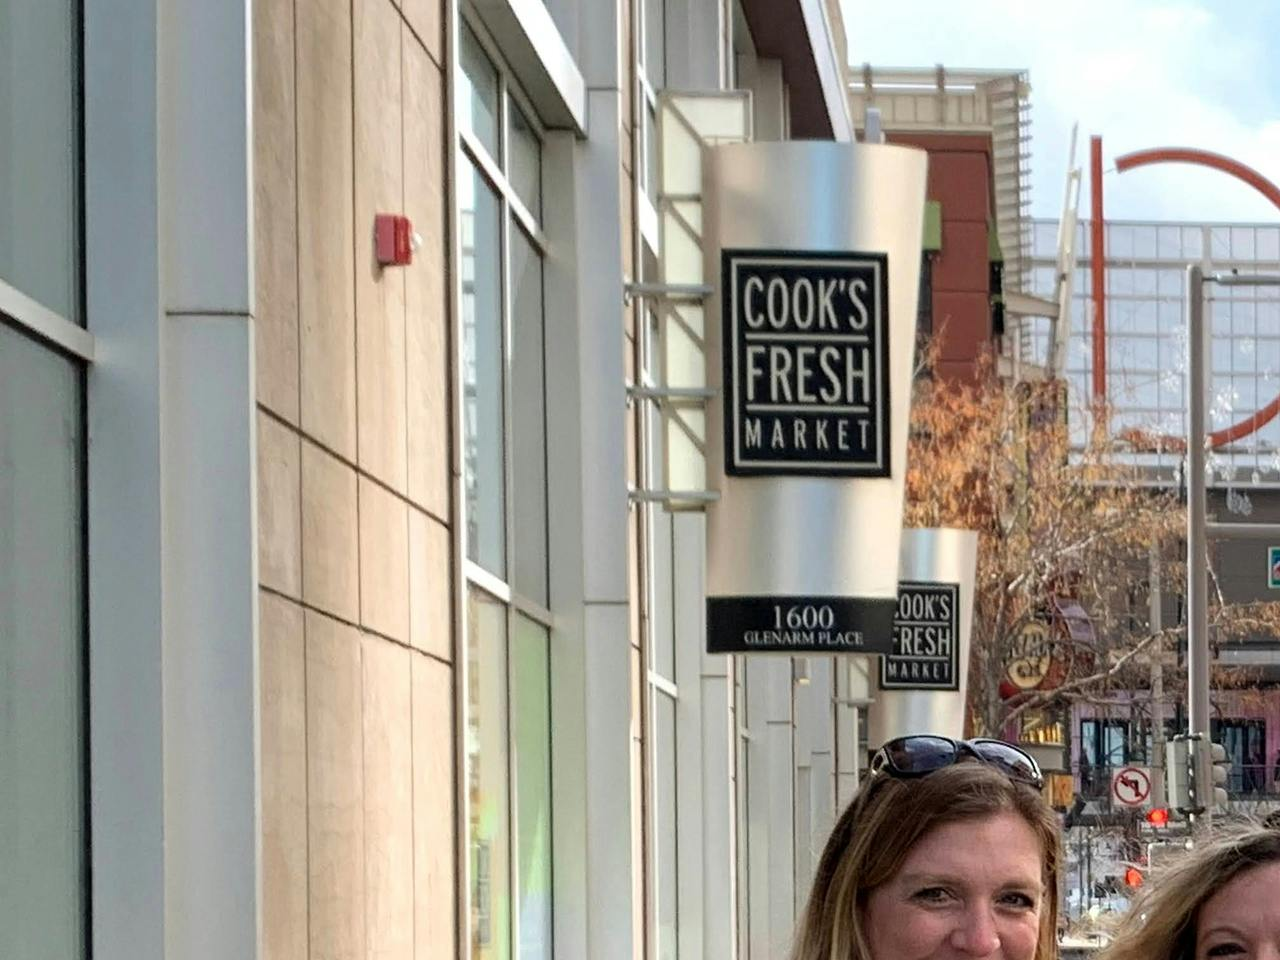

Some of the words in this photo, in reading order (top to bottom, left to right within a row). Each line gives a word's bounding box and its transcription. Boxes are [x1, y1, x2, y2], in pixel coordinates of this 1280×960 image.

[745, 276, 869, 331] COOK'S
[746, 345, 871, 404] FRESH
[746, 418, 871, 451] MARKET
[773, 605, 834, 630] 1600
[894, 595, 950, 621] OOK'S
[743, 631, 815, 646] GLENARM
[818, 631, 864, 646] PLACE
[888, 662, 950, 680] MARKET
